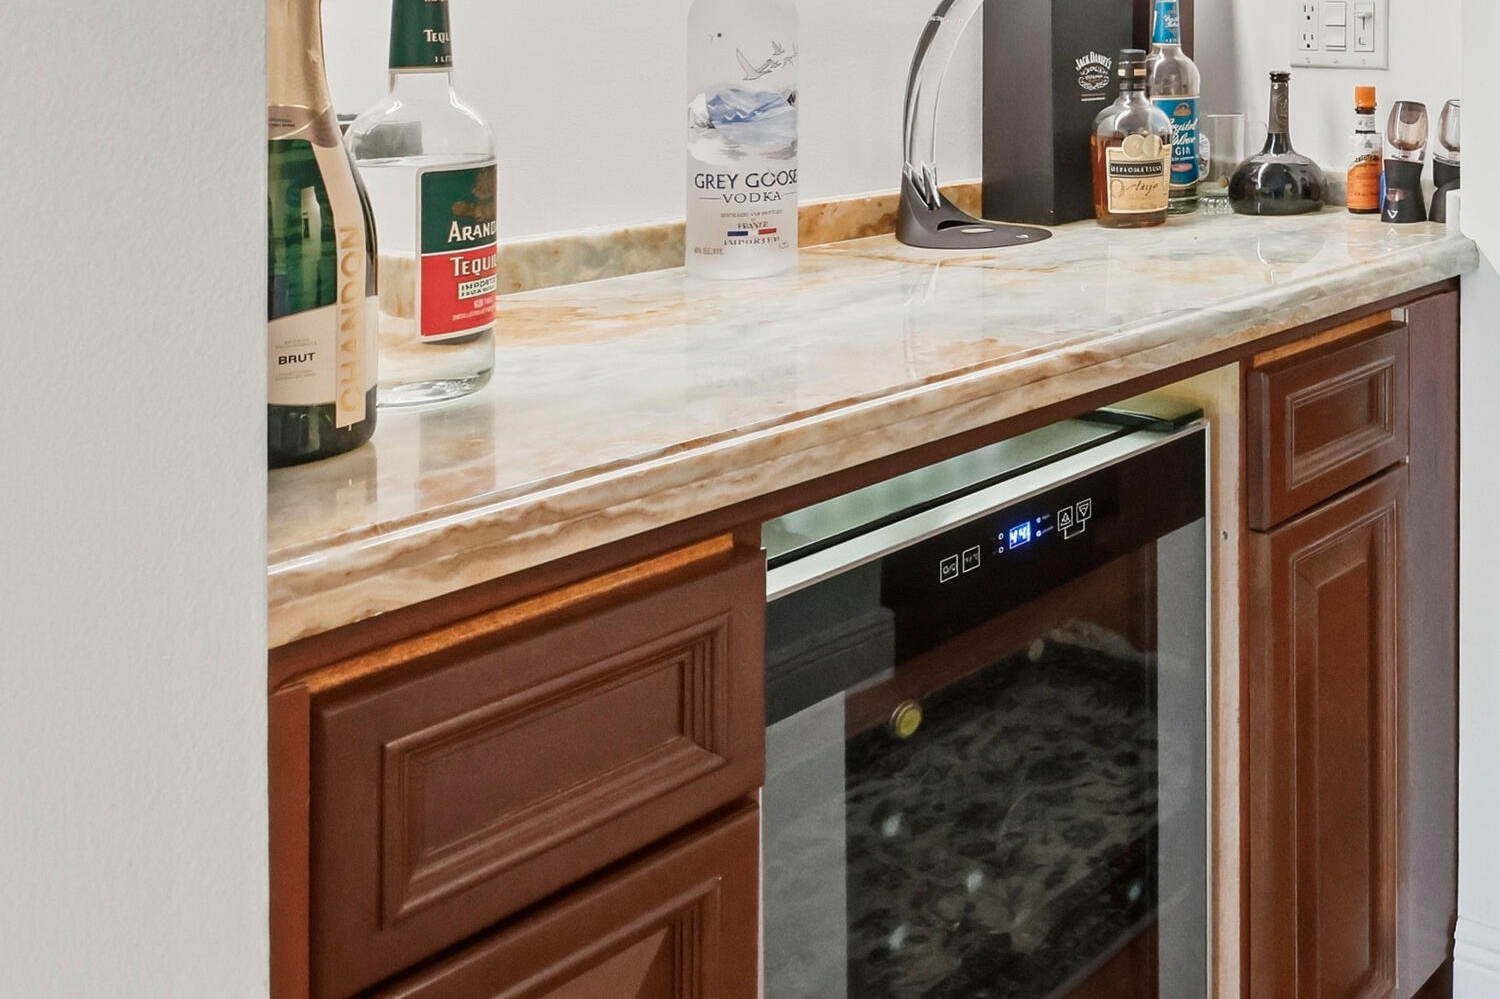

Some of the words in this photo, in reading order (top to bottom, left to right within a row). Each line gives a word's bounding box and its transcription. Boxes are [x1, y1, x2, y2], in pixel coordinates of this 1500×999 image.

[694, 172, 739, 190] GREY
[722, 191, 782, 204] VODKA
[340, 225, 362, 413] CHANDON
[278, 352, 316, 365] BRUT
